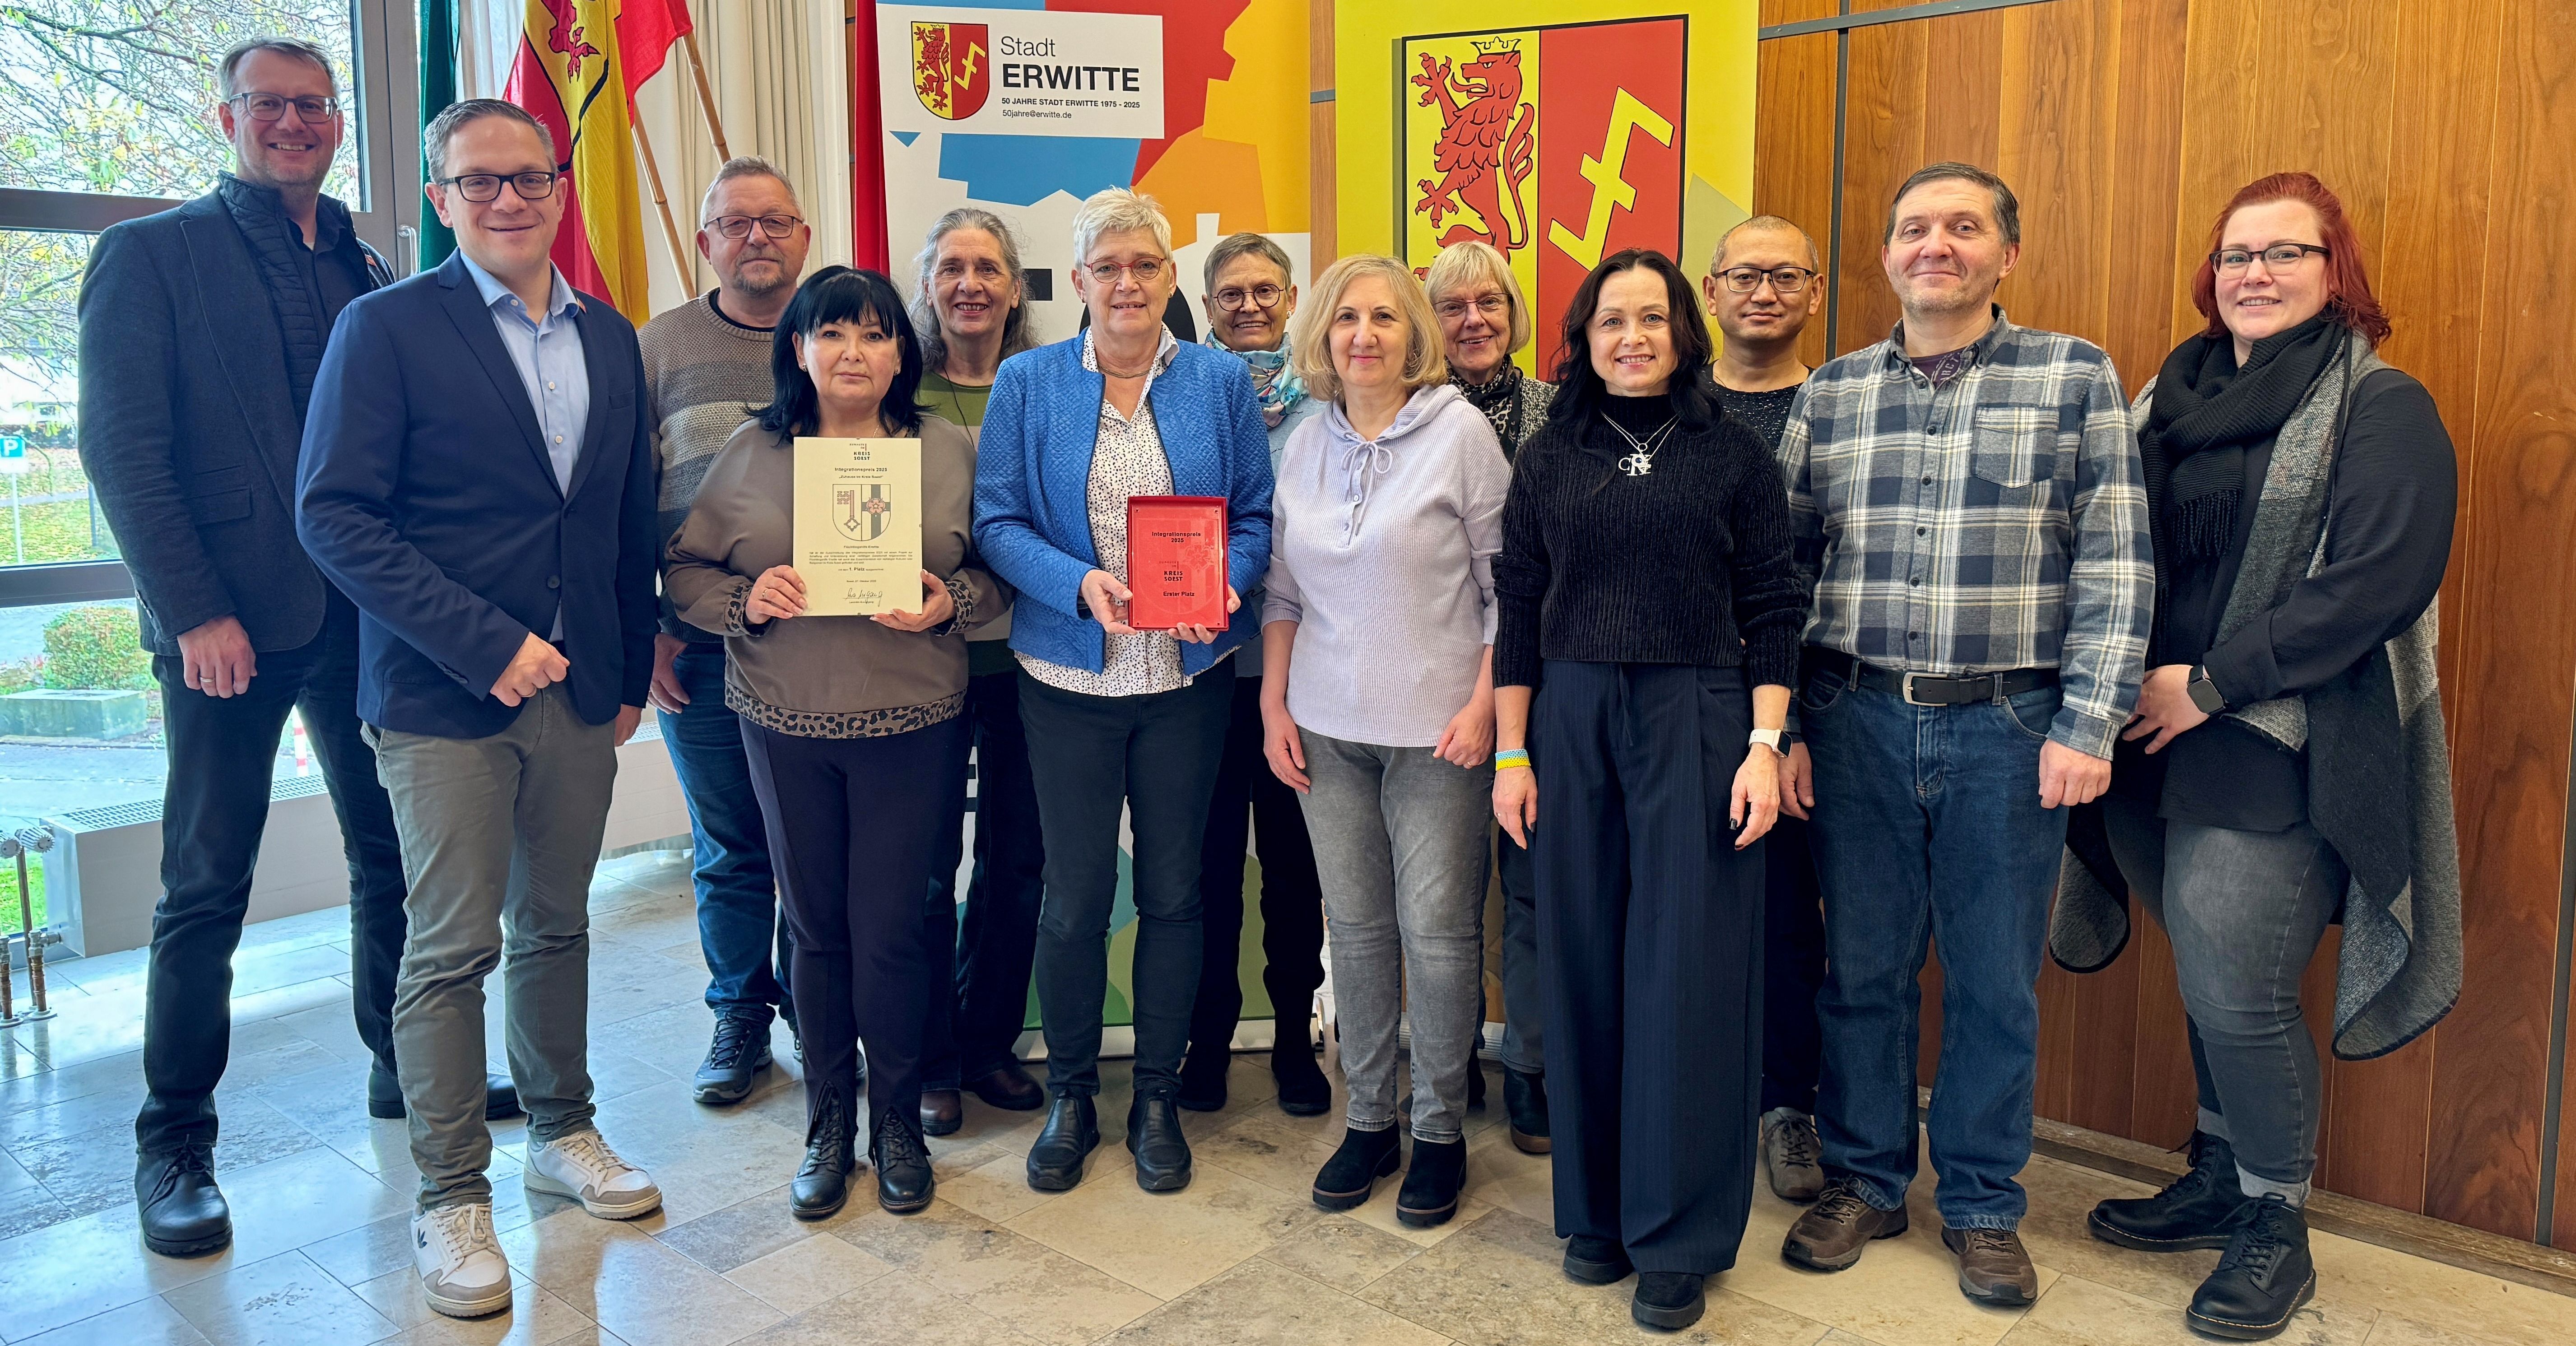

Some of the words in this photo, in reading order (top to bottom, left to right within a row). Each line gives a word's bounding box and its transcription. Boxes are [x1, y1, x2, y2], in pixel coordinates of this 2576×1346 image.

[1000, 36, 1056, 57] Stadt
[1002, 63, 1139, 92] ERWITTE
[1002, 109, 1072, 119] 50jahre@erwitte.de
[4, 439, 19, 456] P
